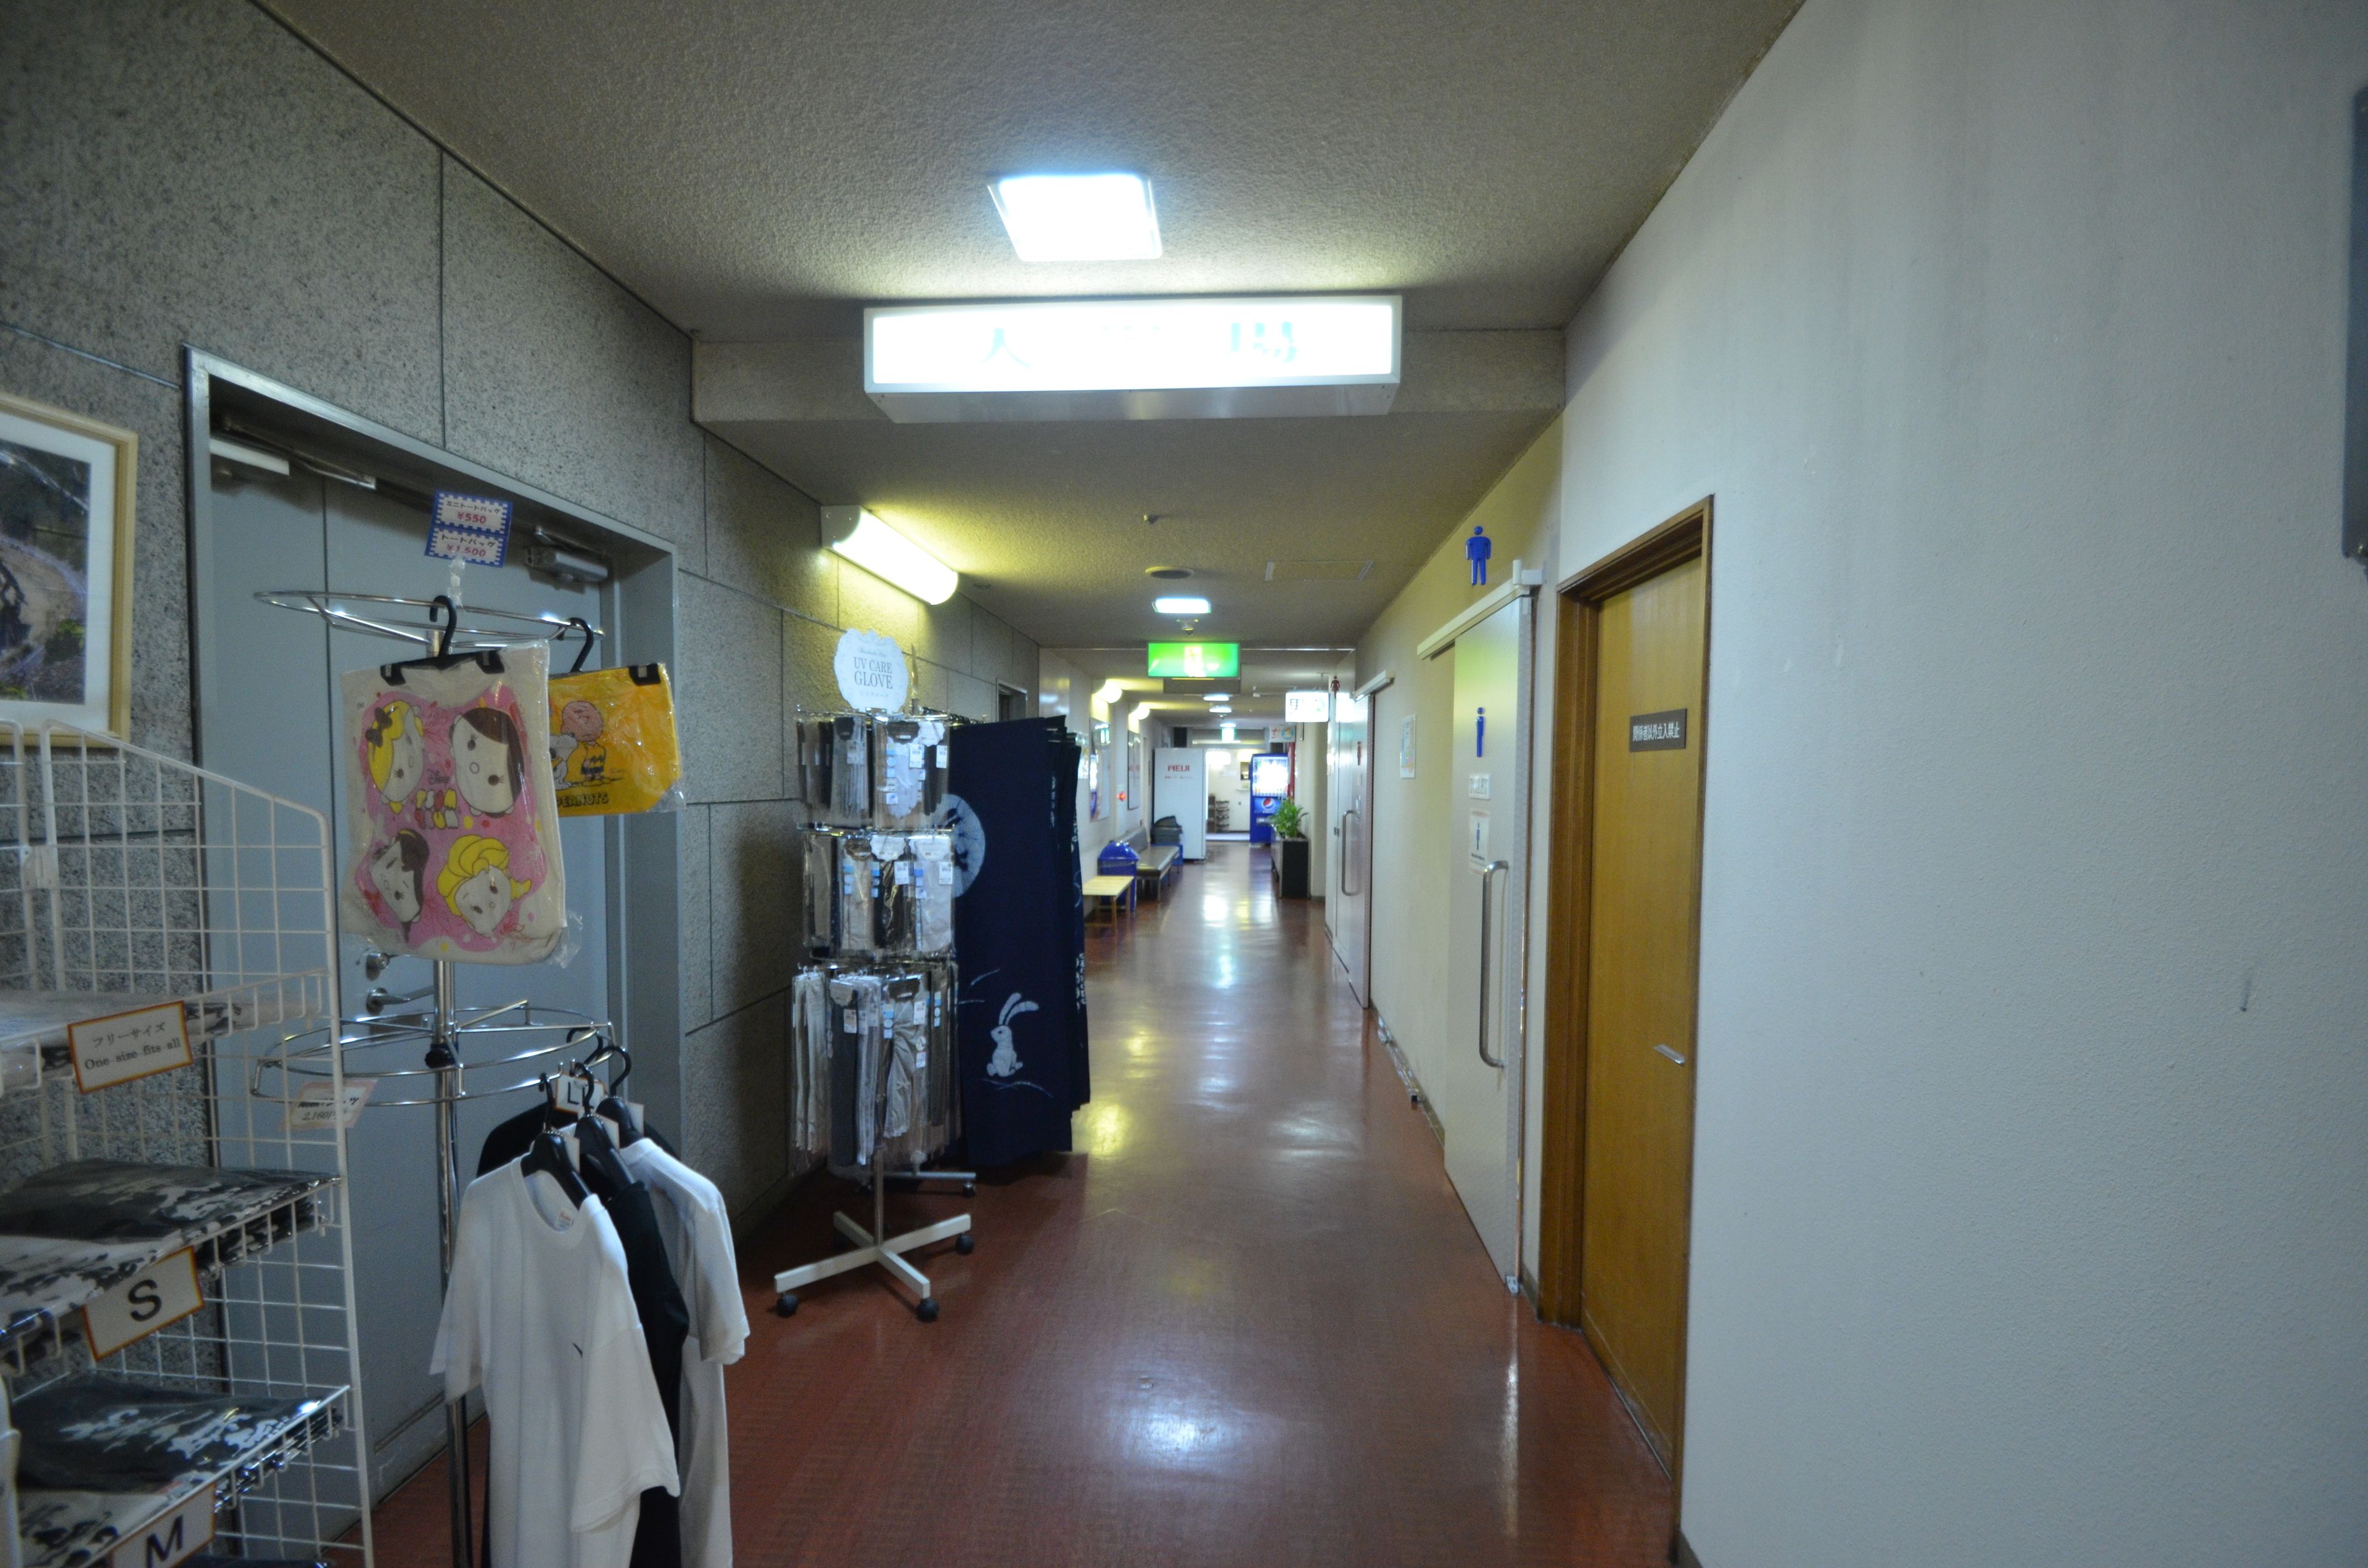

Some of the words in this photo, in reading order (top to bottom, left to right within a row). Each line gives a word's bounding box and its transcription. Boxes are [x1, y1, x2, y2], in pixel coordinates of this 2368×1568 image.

[446, 500, 501, 514] ミニトートバッグ
[458, 511, 487, 523] ¥550
[441, 534, 495, 548] トートバッグ
[853, 657, 867, 670] UV
[869, 659, 893, 674] CARE
[854, 670, 893, 689] GLOVE
[1632, 721, 1680, 741] 関係者以外立入禁止
[1470, 778, 1488, 795] TOILET
[556, 792, 609, 808] PEANUTS
[92, 1021, 166, 1048] フリーサイズ
[127, 1278, 162, 1321] S
[146, 1514, 184, 1568] M
